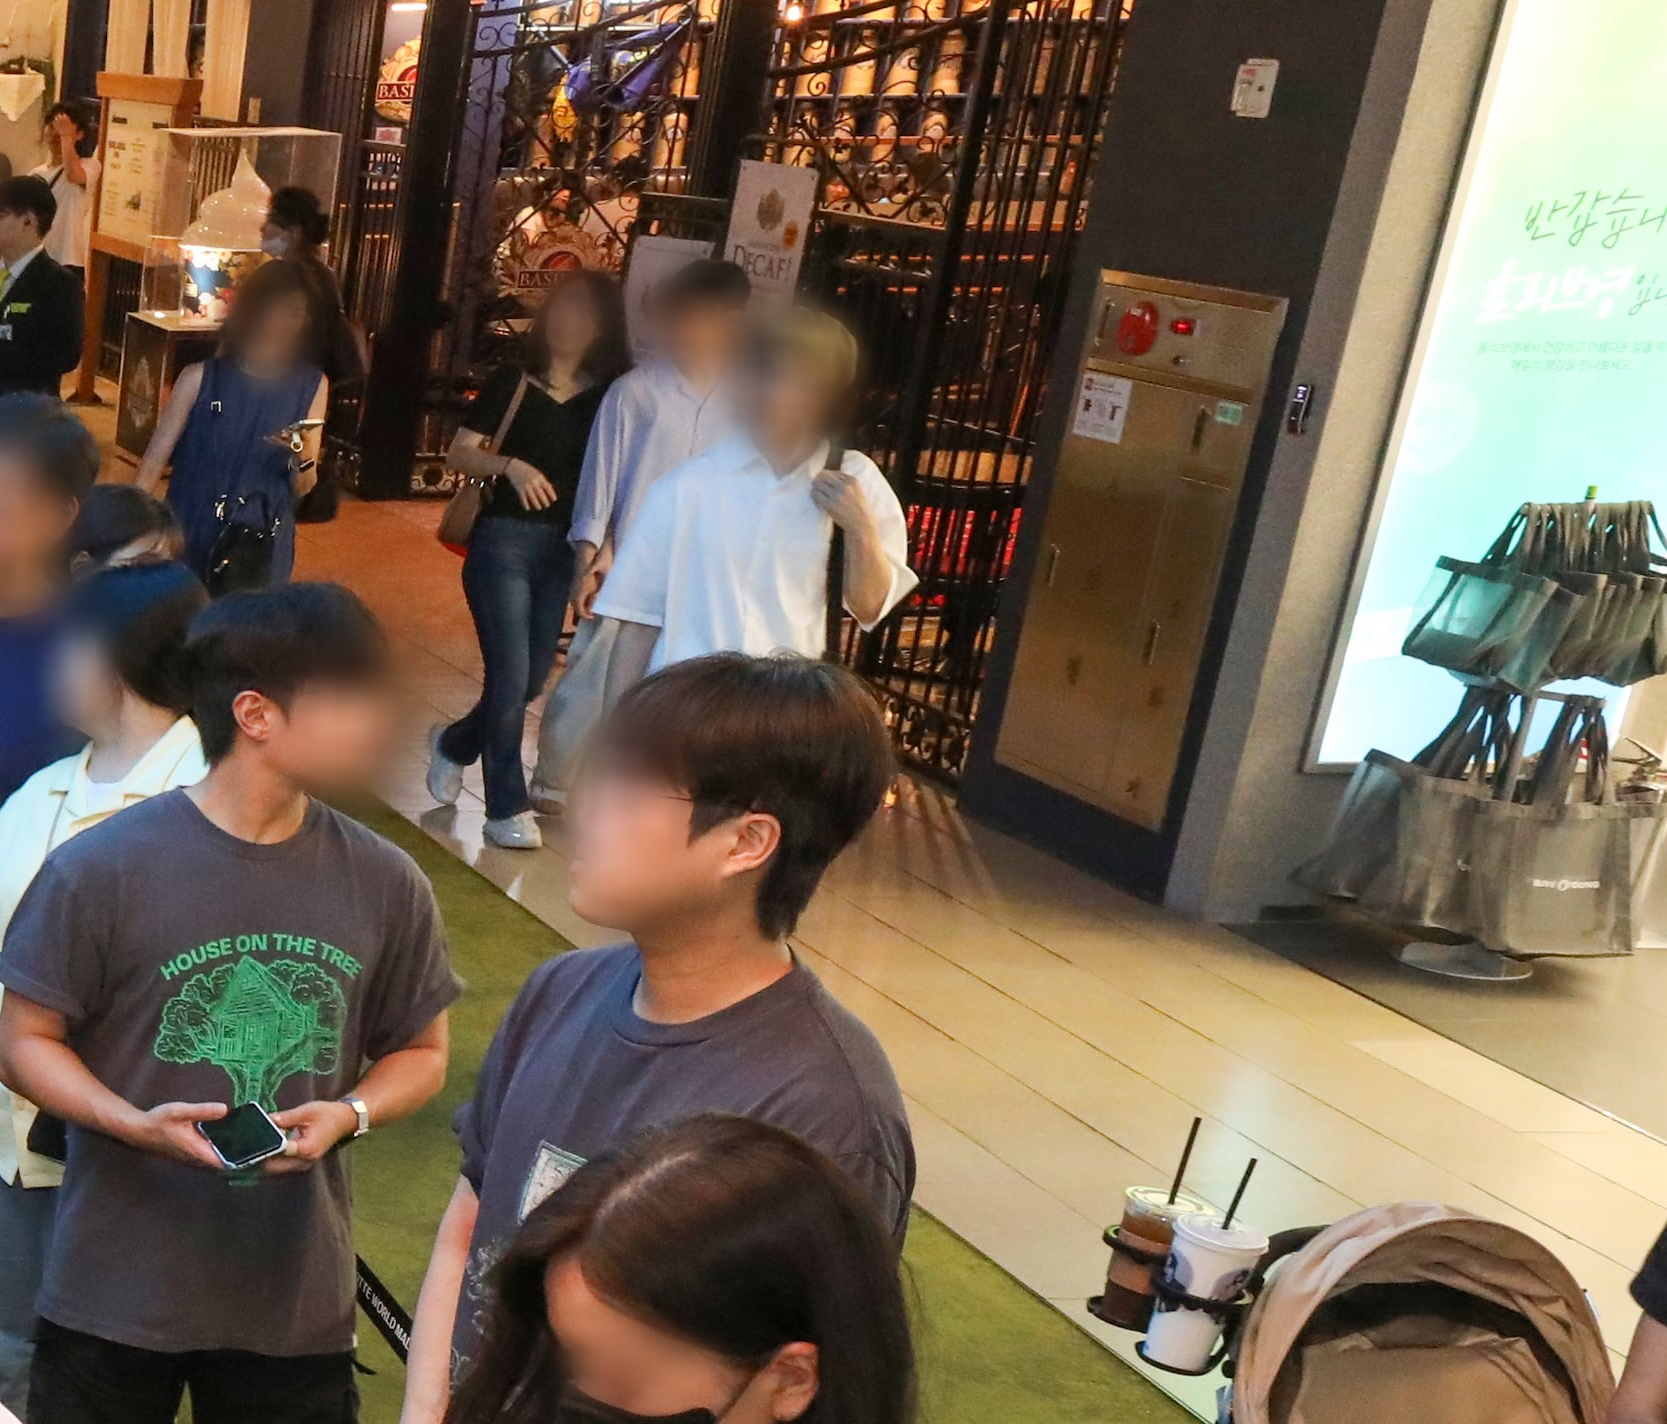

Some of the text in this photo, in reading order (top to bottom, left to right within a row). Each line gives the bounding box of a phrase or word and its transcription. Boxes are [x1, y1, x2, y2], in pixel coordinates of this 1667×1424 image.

[378, 82, 415, 99] BASI
[160, 933, 364, 981] HOUSE ON THE TREE
[357, 1273, 411, 1351] TTE WORLD MAL
